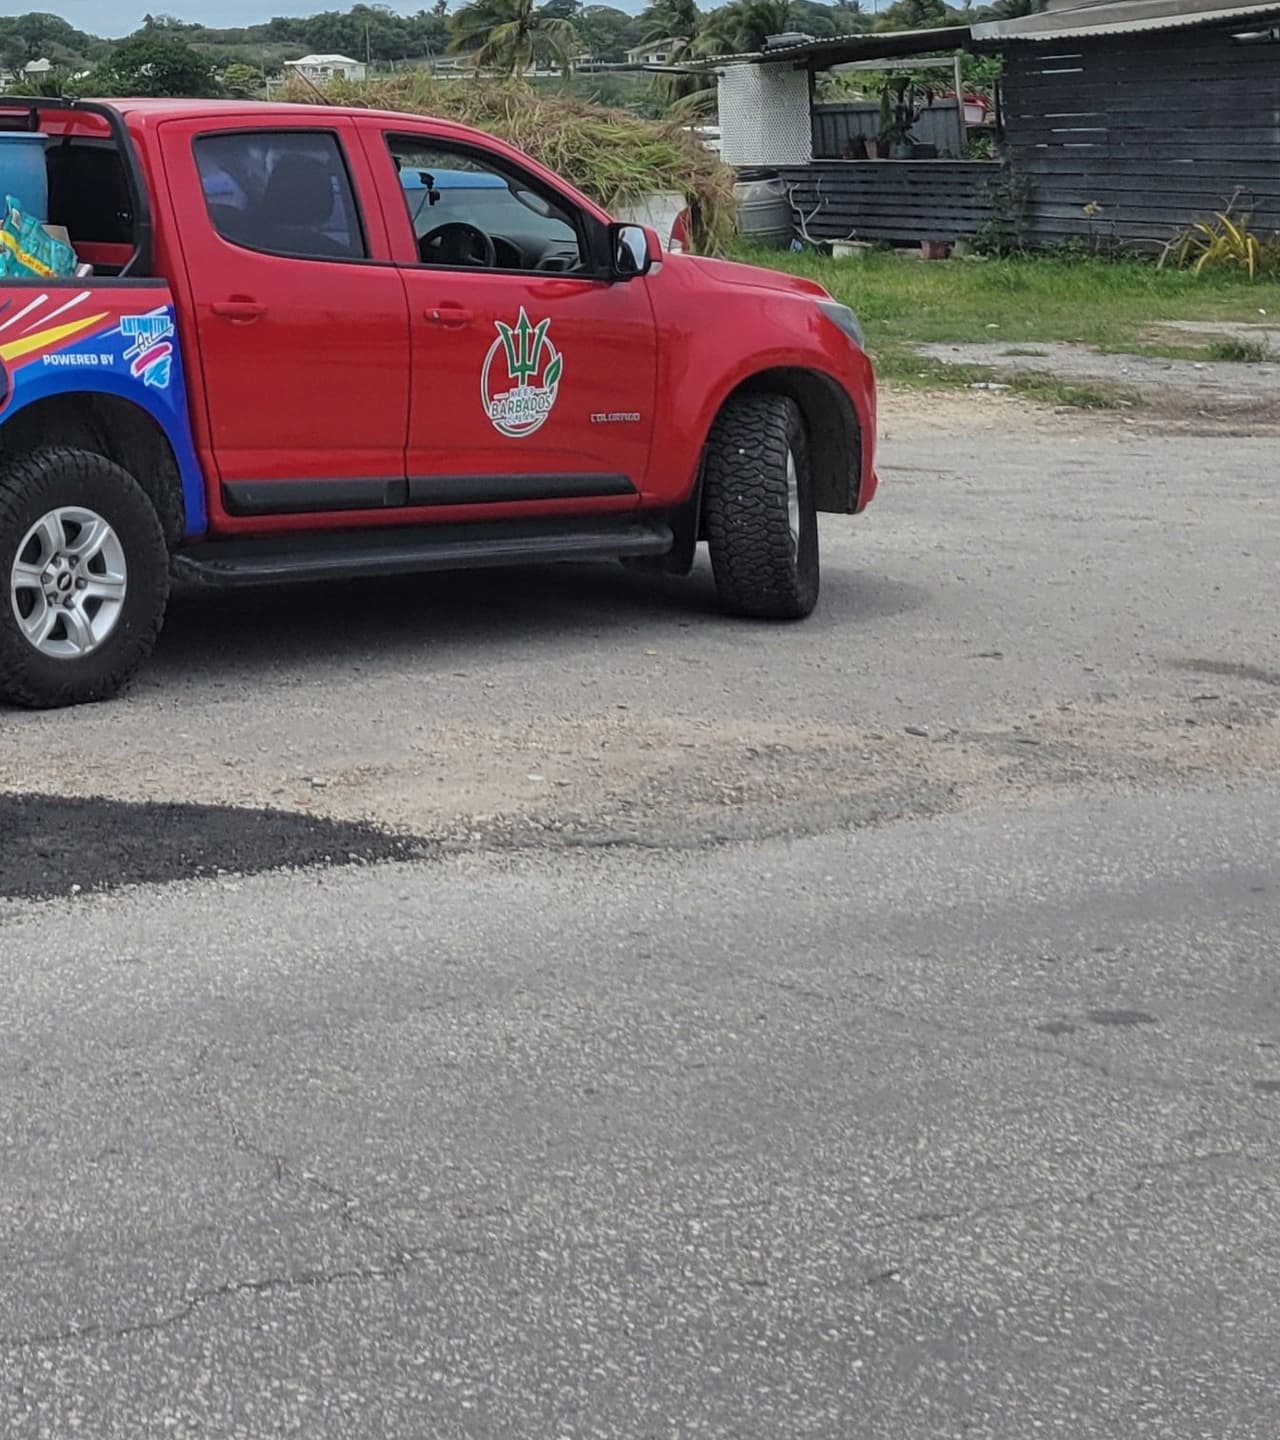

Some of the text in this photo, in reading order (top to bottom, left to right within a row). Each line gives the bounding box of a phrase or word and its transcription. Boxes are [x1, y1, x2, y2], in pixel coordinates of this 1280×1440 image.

[42, 353, 114, 366] POWERED BY
[491, 395, 552, 417] BARBADOS
